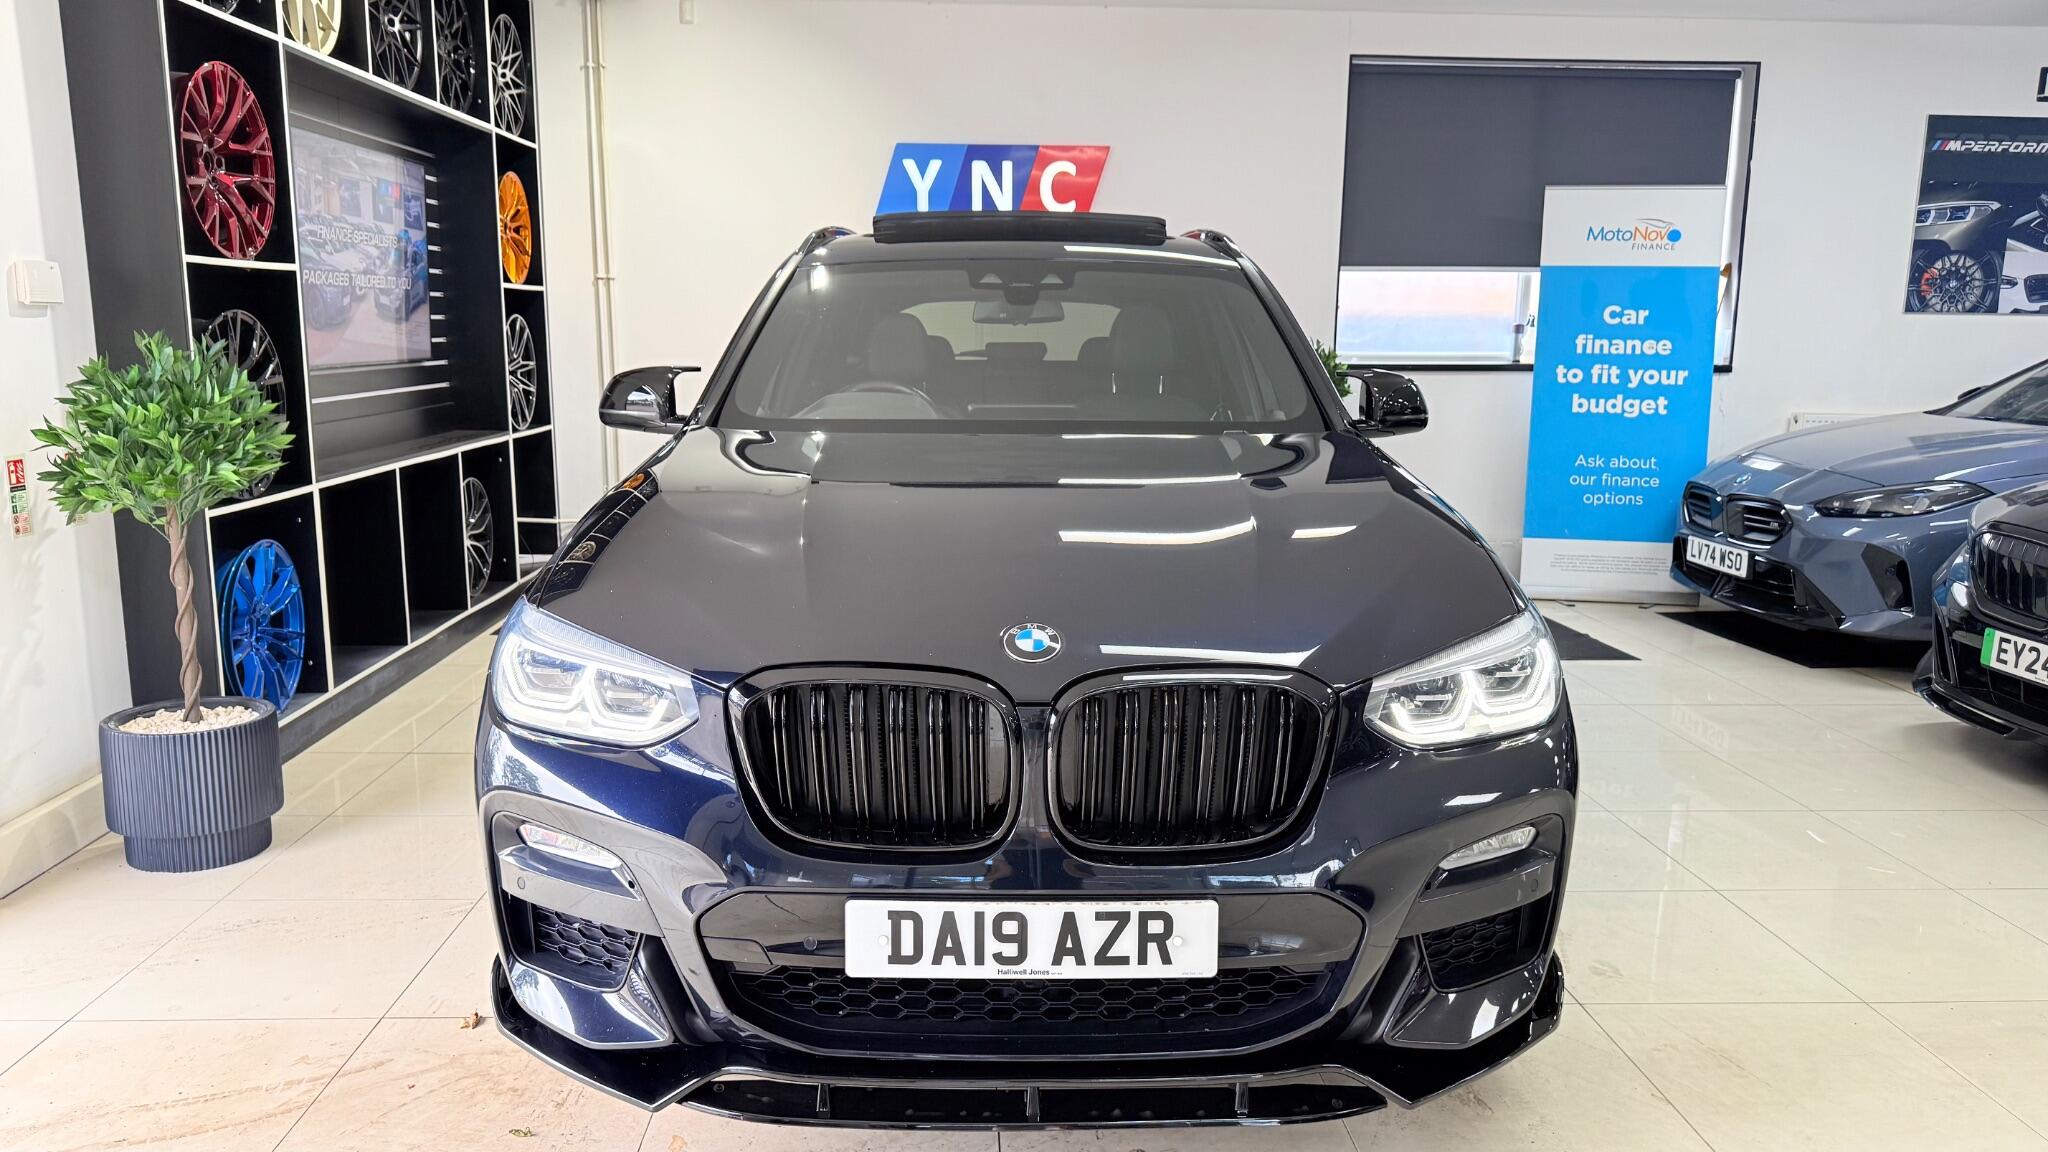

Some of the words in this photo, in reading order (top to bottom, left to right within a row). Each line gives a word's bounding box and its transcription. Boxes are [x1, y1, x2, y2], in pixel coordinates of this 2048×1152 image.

[902, 158, 1076, 212] YNC
[317, 226, 353, 243] FINANCE
[353, 231, 398, 248] SPECIALISTS
[1631, 243, 1676, 251] FINANCE
[303, 270, 350, 286] PACKAGES
[351, 274, 385, 288] TAILORED
[398, 277, 412, 290] YOU
[1603, 305, 1649, 325] Car
[1575, 335, 1673, 355] finance
[1556, 365, 1583, 384] to
[1591, 365, 1621, 384] fit
[1627, 369, 1689, 389] your
[1571, 394, 1668, 417] budget
[1575, 454, 1605, 468] Ask
[1569, 474, 1597, 486] our
[1601, 474, 1660, 488] finance
[1583, 493, 1643, 506] options
[1690, 539, 1716, 564] LV74
[1009, 623, 1056, 636] BMW
[1051, 911, 1174, 966] AZR
[997, 968, 1027, 976] Halliwell
[1028, 968, 1050, 976] Jones
